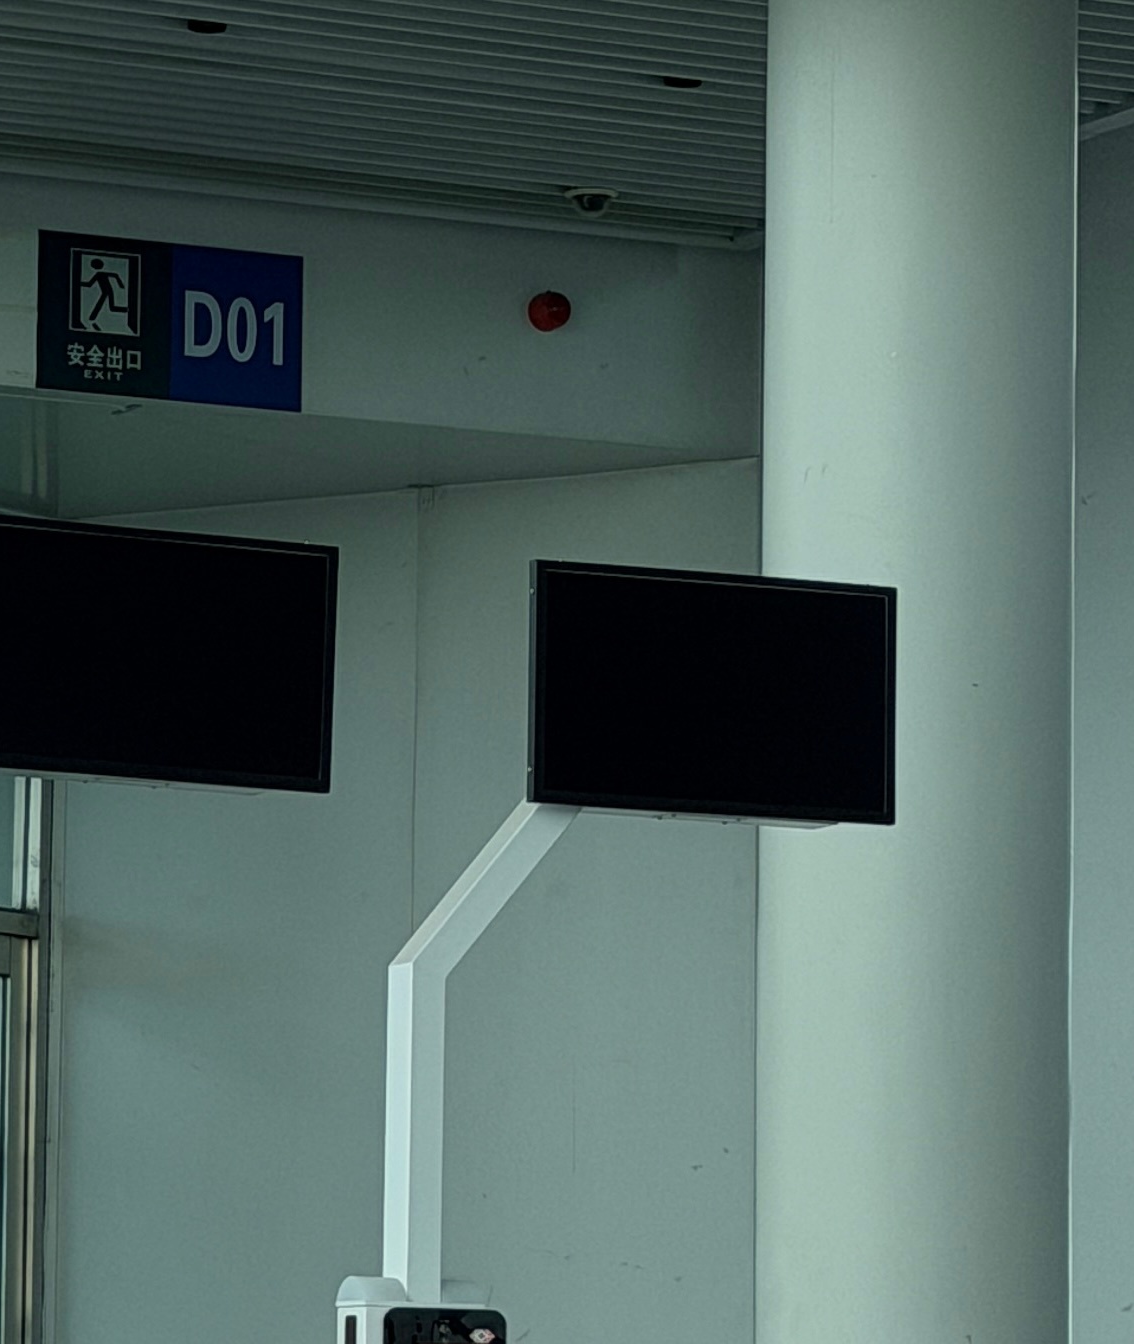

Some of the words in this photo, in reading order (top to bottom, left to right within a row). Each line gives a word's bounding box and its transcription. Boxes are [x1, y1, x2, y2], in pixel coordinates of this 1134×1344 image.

[183, 289, 285, 367] D01
[67, 341, 142, 371] 安全出口
[83, 368, 124, 382] EXIT
